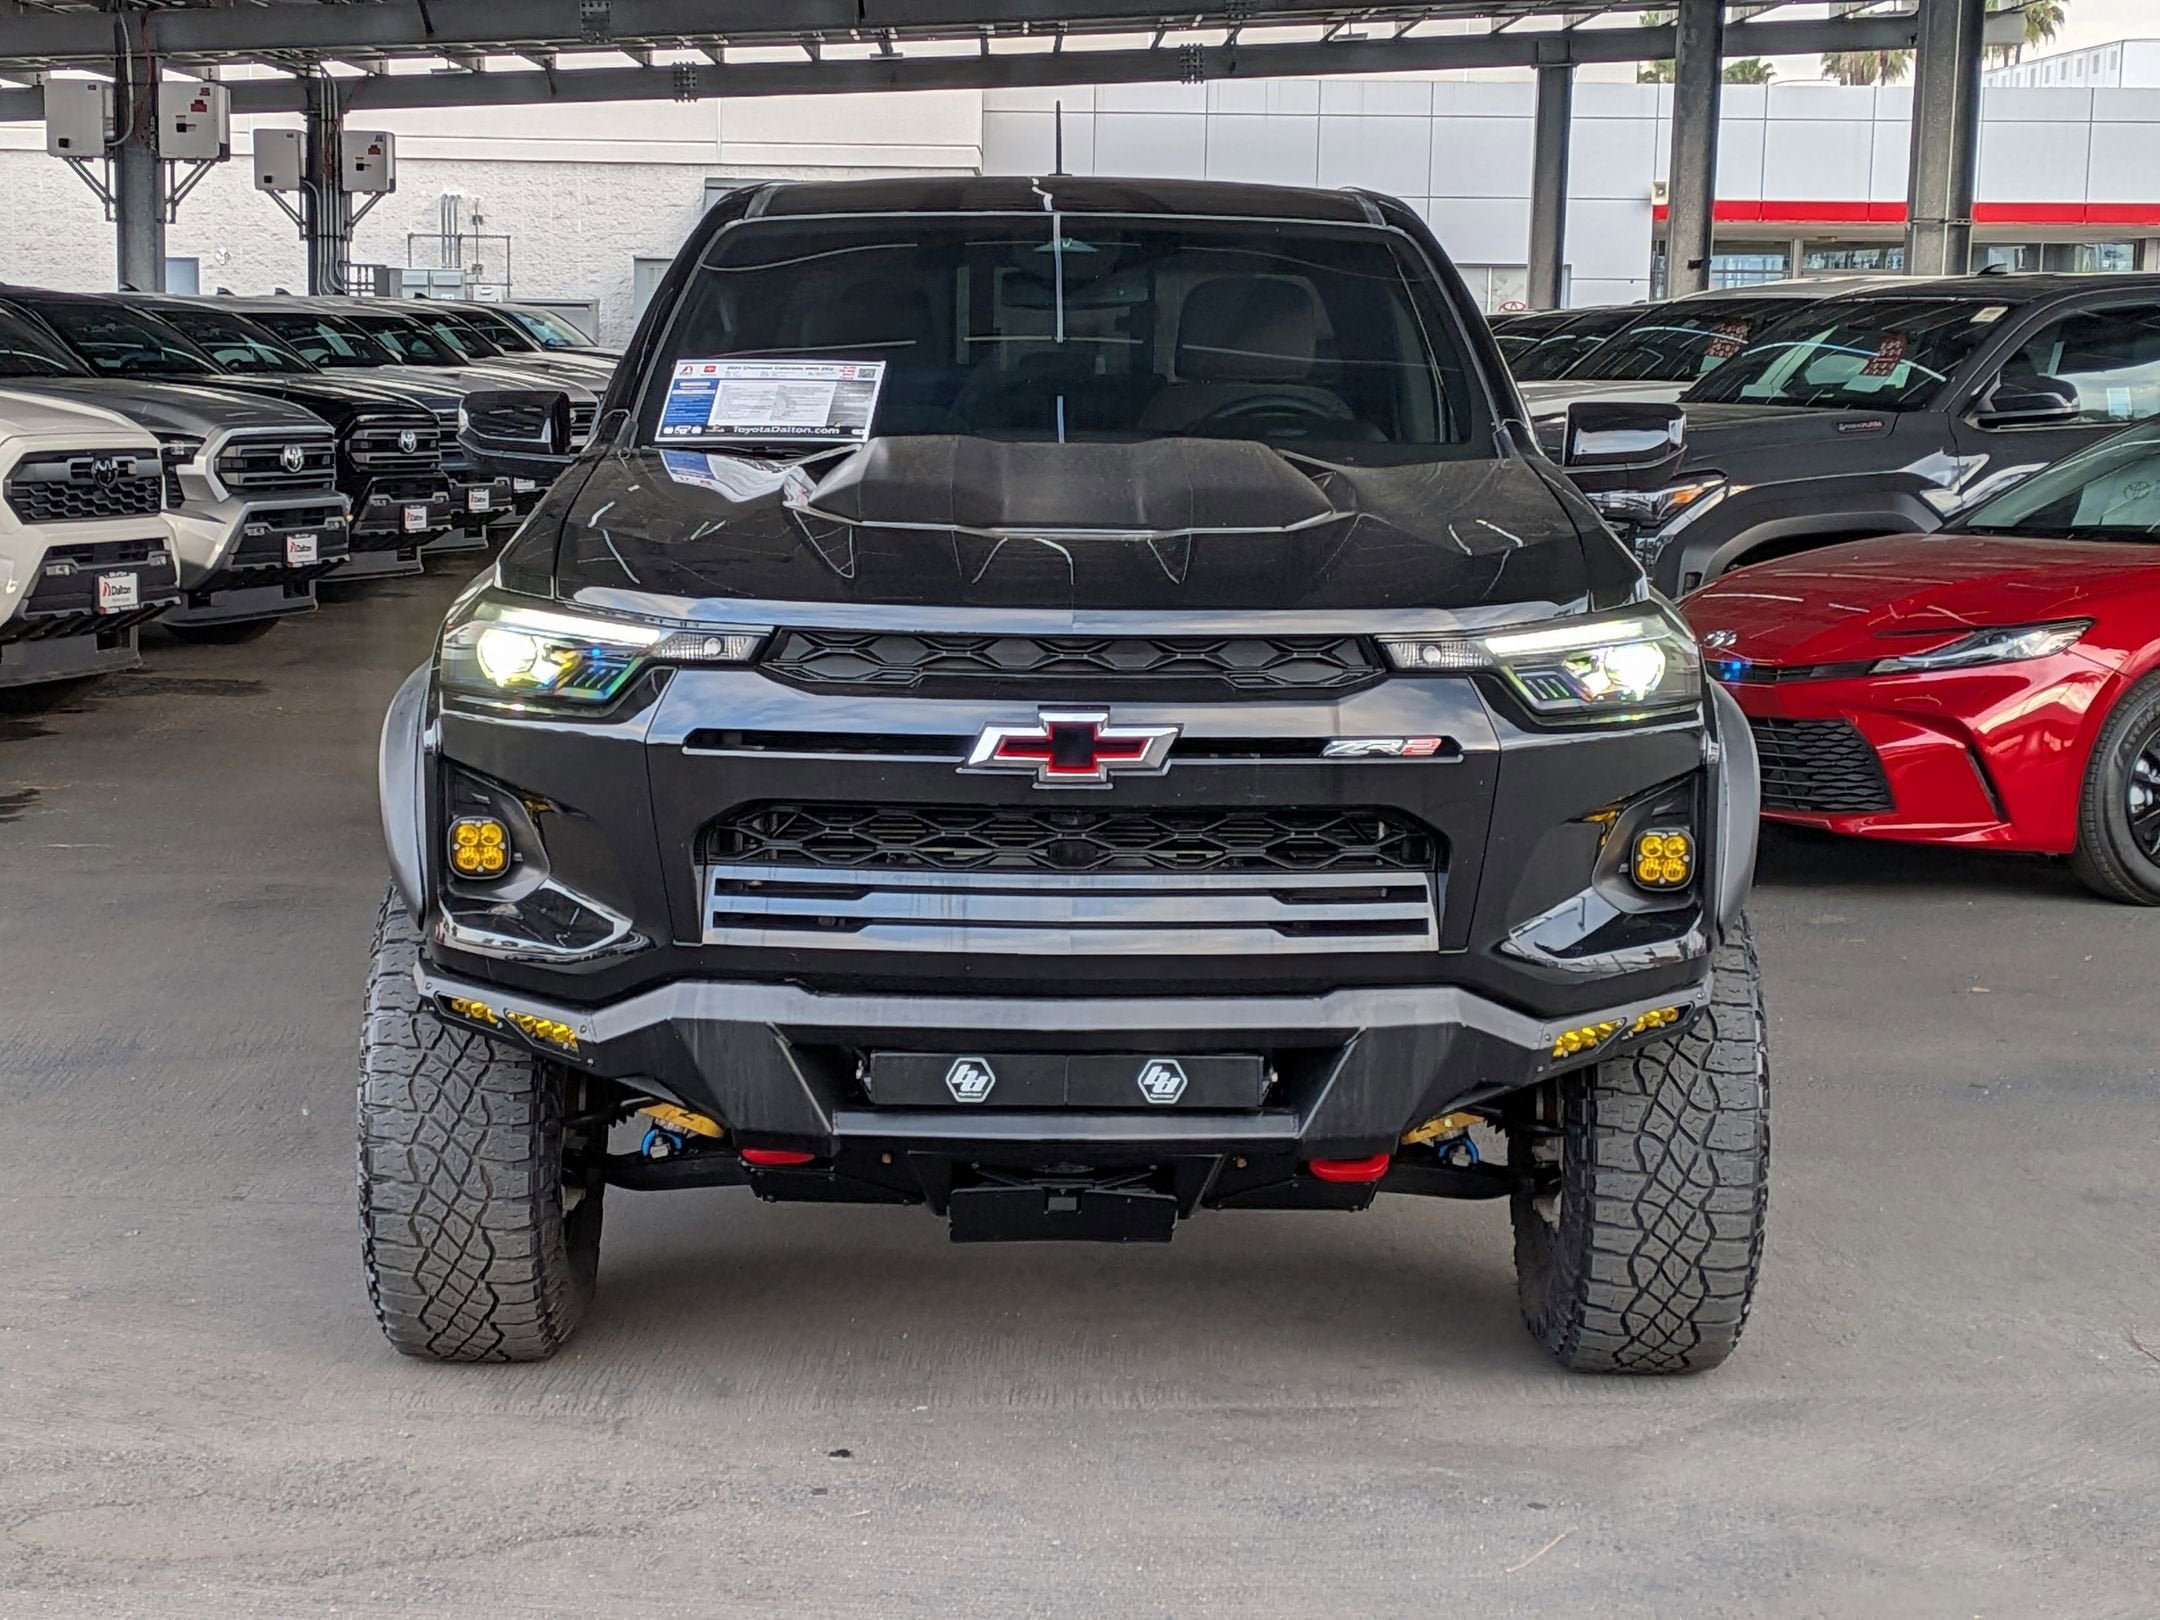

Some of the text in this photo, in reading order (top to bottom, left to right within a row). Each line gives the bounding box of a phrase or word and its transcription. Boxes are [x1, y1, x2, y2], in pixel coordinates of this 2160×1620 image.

[733, 425, 840, 435] ToyotaDalton.com
[111, 585, 132, 596] Dalton
[1322, 738, 1442, 756] ZR2
